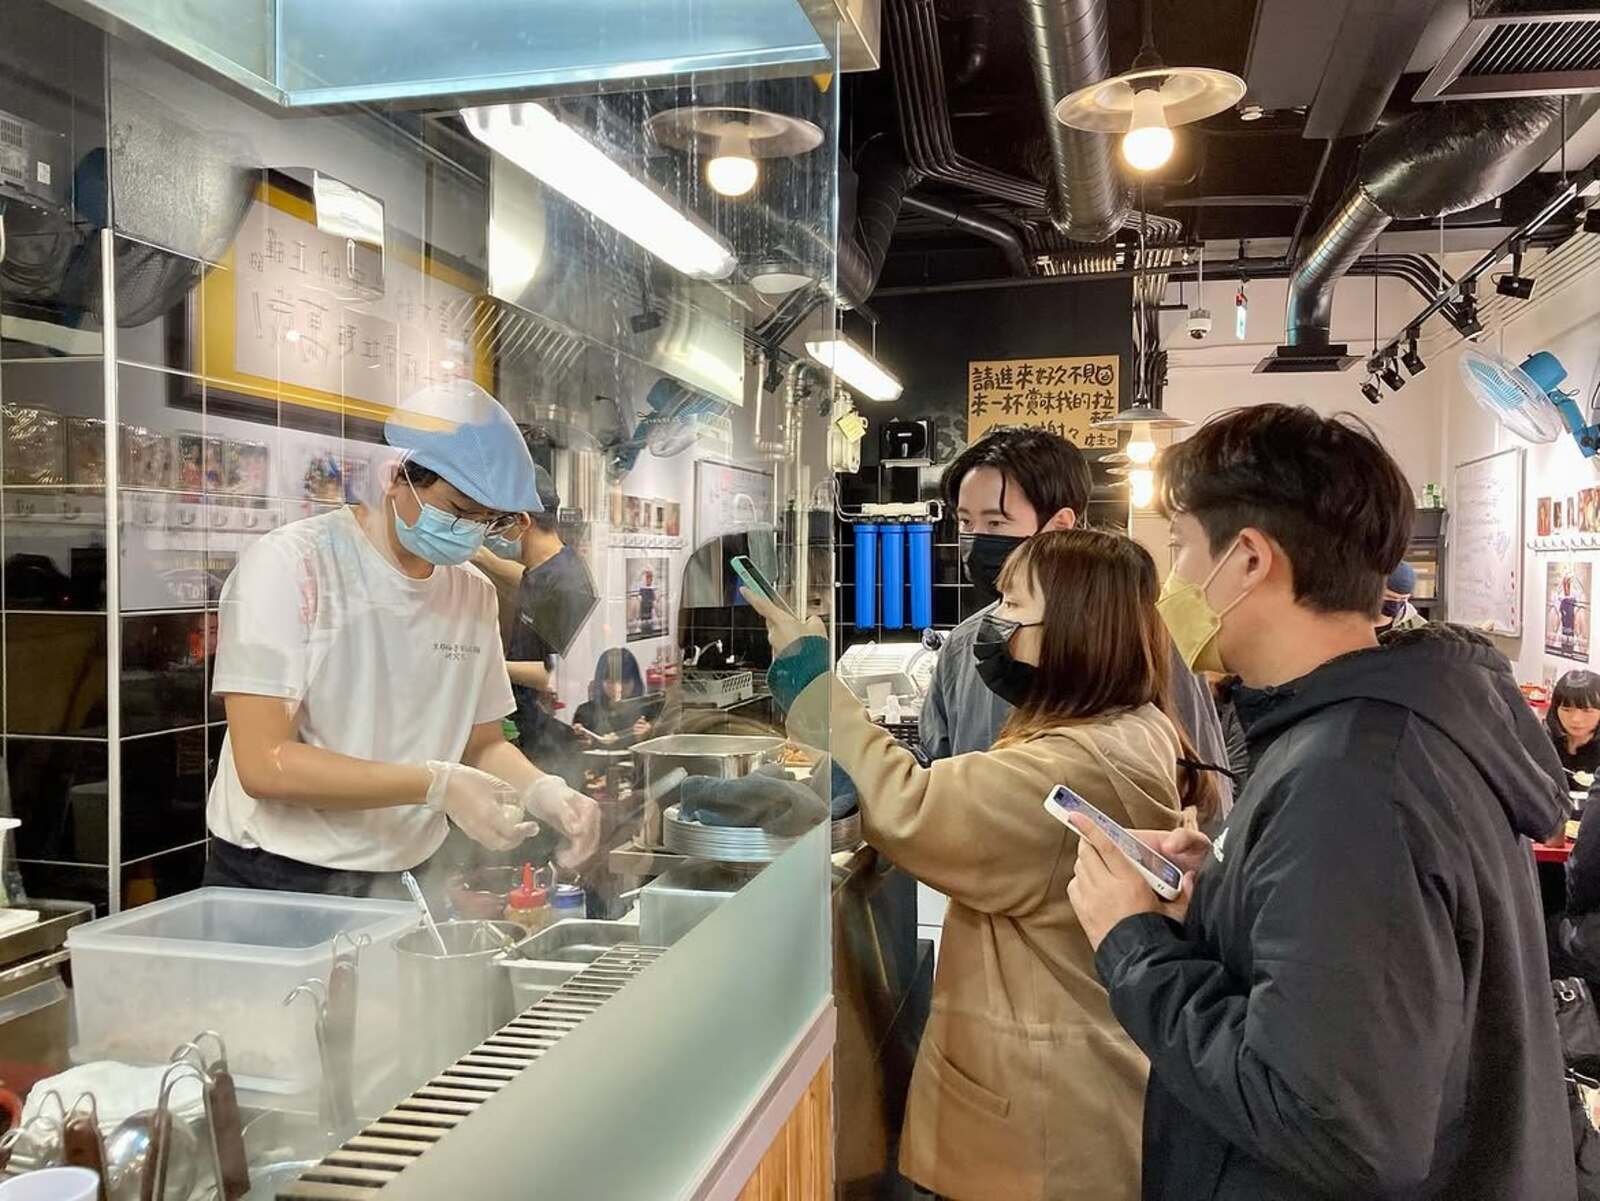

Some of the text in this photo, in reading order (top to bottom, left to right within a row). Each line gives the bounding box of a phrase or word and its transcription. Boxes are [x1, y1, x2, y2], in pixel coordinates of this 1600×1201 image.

[971, 363, 1095, 391] 請進來好久不見
